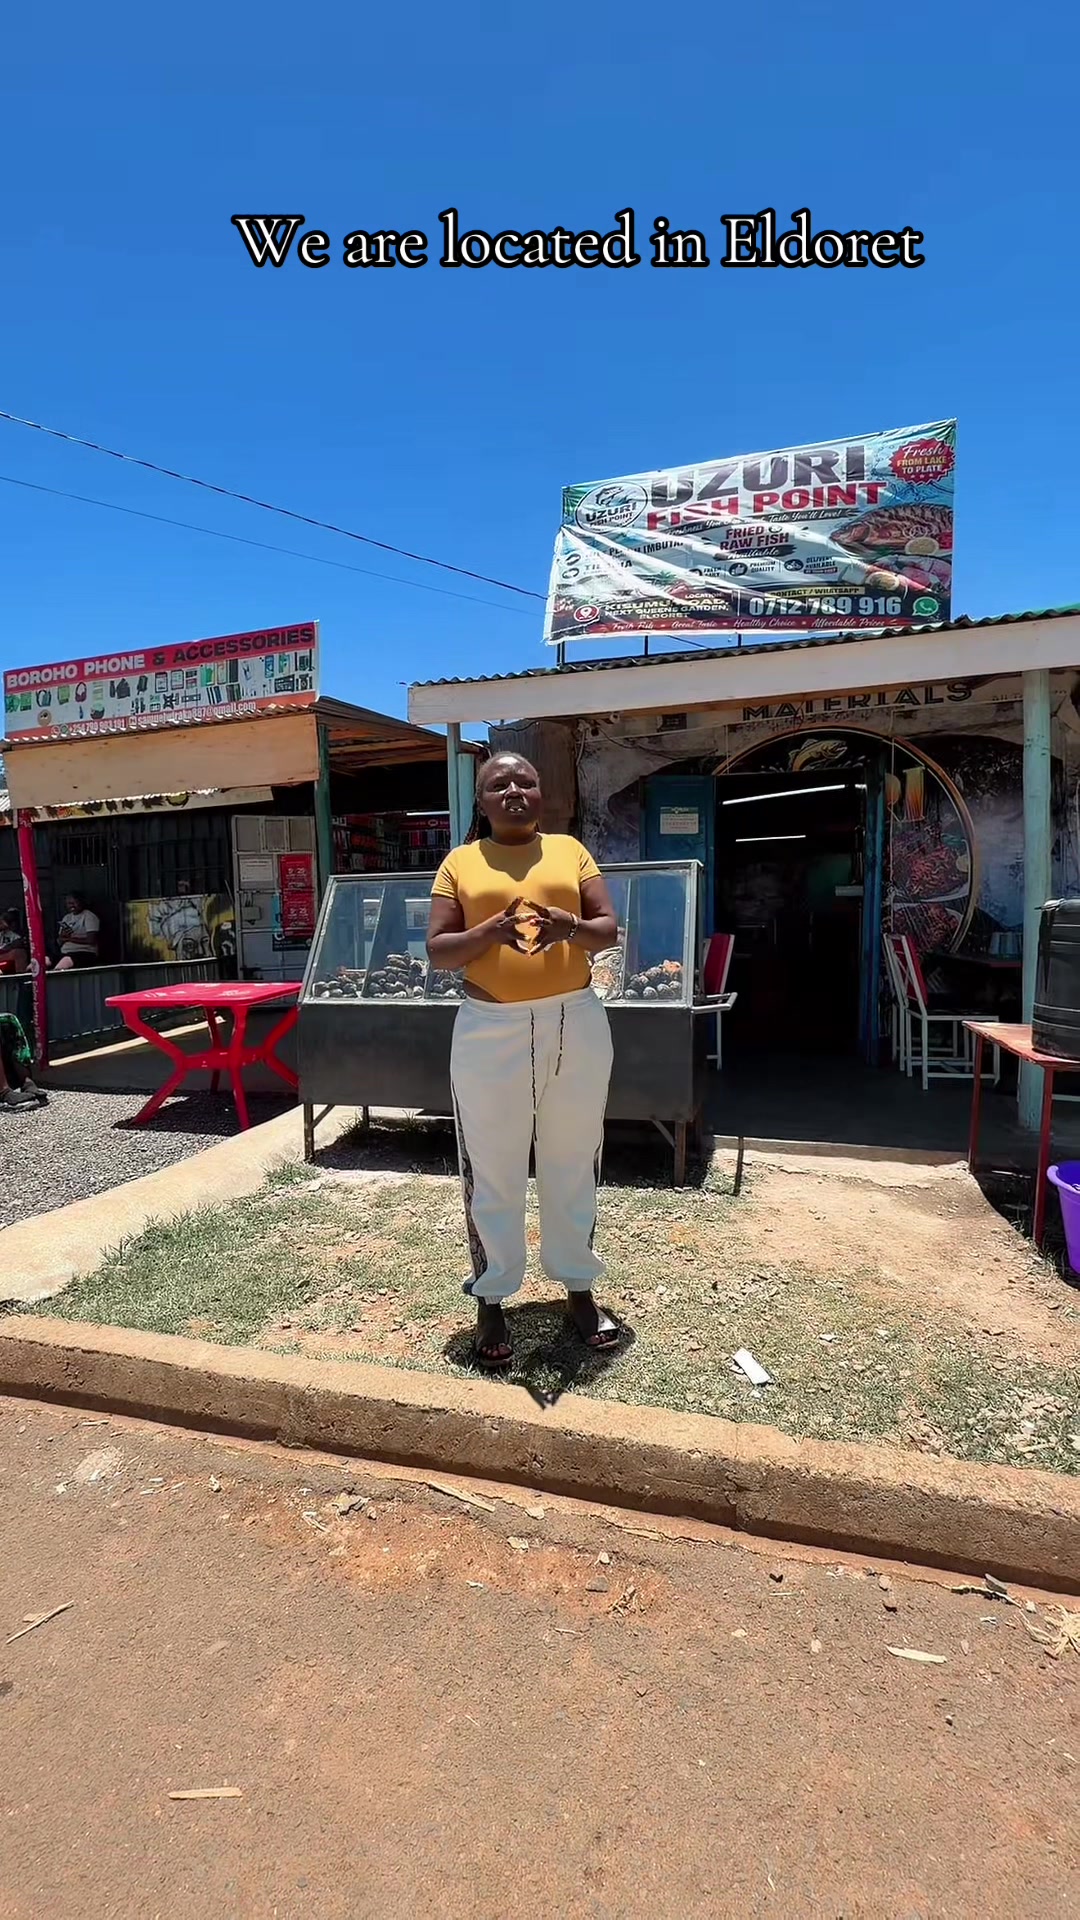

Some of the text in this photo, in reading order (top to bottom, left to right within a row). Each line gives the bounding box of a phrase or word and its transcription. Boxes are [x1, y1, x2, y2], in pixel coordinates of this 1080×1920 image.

[903, 443, 945, 460] Fresh
[896, 455, 947, 468] FROM LAKE
[651, 446, 866, 508] UZURI
[902, 464, 942, 475] TO PLATE
[585, 502, 637, 522] UZURI
[647, 482, 887, 531] FISH POINT
[608, 511, 633, 524] POINT
[769, 514, 791, 524] Taste
[792, 511, 817, 522] You'll
[818, 509, 842, 520] Love!
[725, 525, 764, 540] FRIED
[719, 532, 790, 551] RAW FISH
[727, 546, 780, 560] Available
[750, 560, 777, 568] PREMIUM
[750, 566, 775, 574] QUALITY
[814, 587, 860, 596] WHATSAPP
[604, 609, 633, 617] NEXT
[750, 596, 902, 616] 0712 789 916
[733, 618, 769, 629] Healthy
[769, 618, 797, 628] Choice
[811, 617, 857, 628] Affordable
[859, 617, 884, 627] Prices
[6, 628, 314, 689] BOROHO PHONE & ACCESSORIES
[742, 682, 973, 722] MATERIALS
